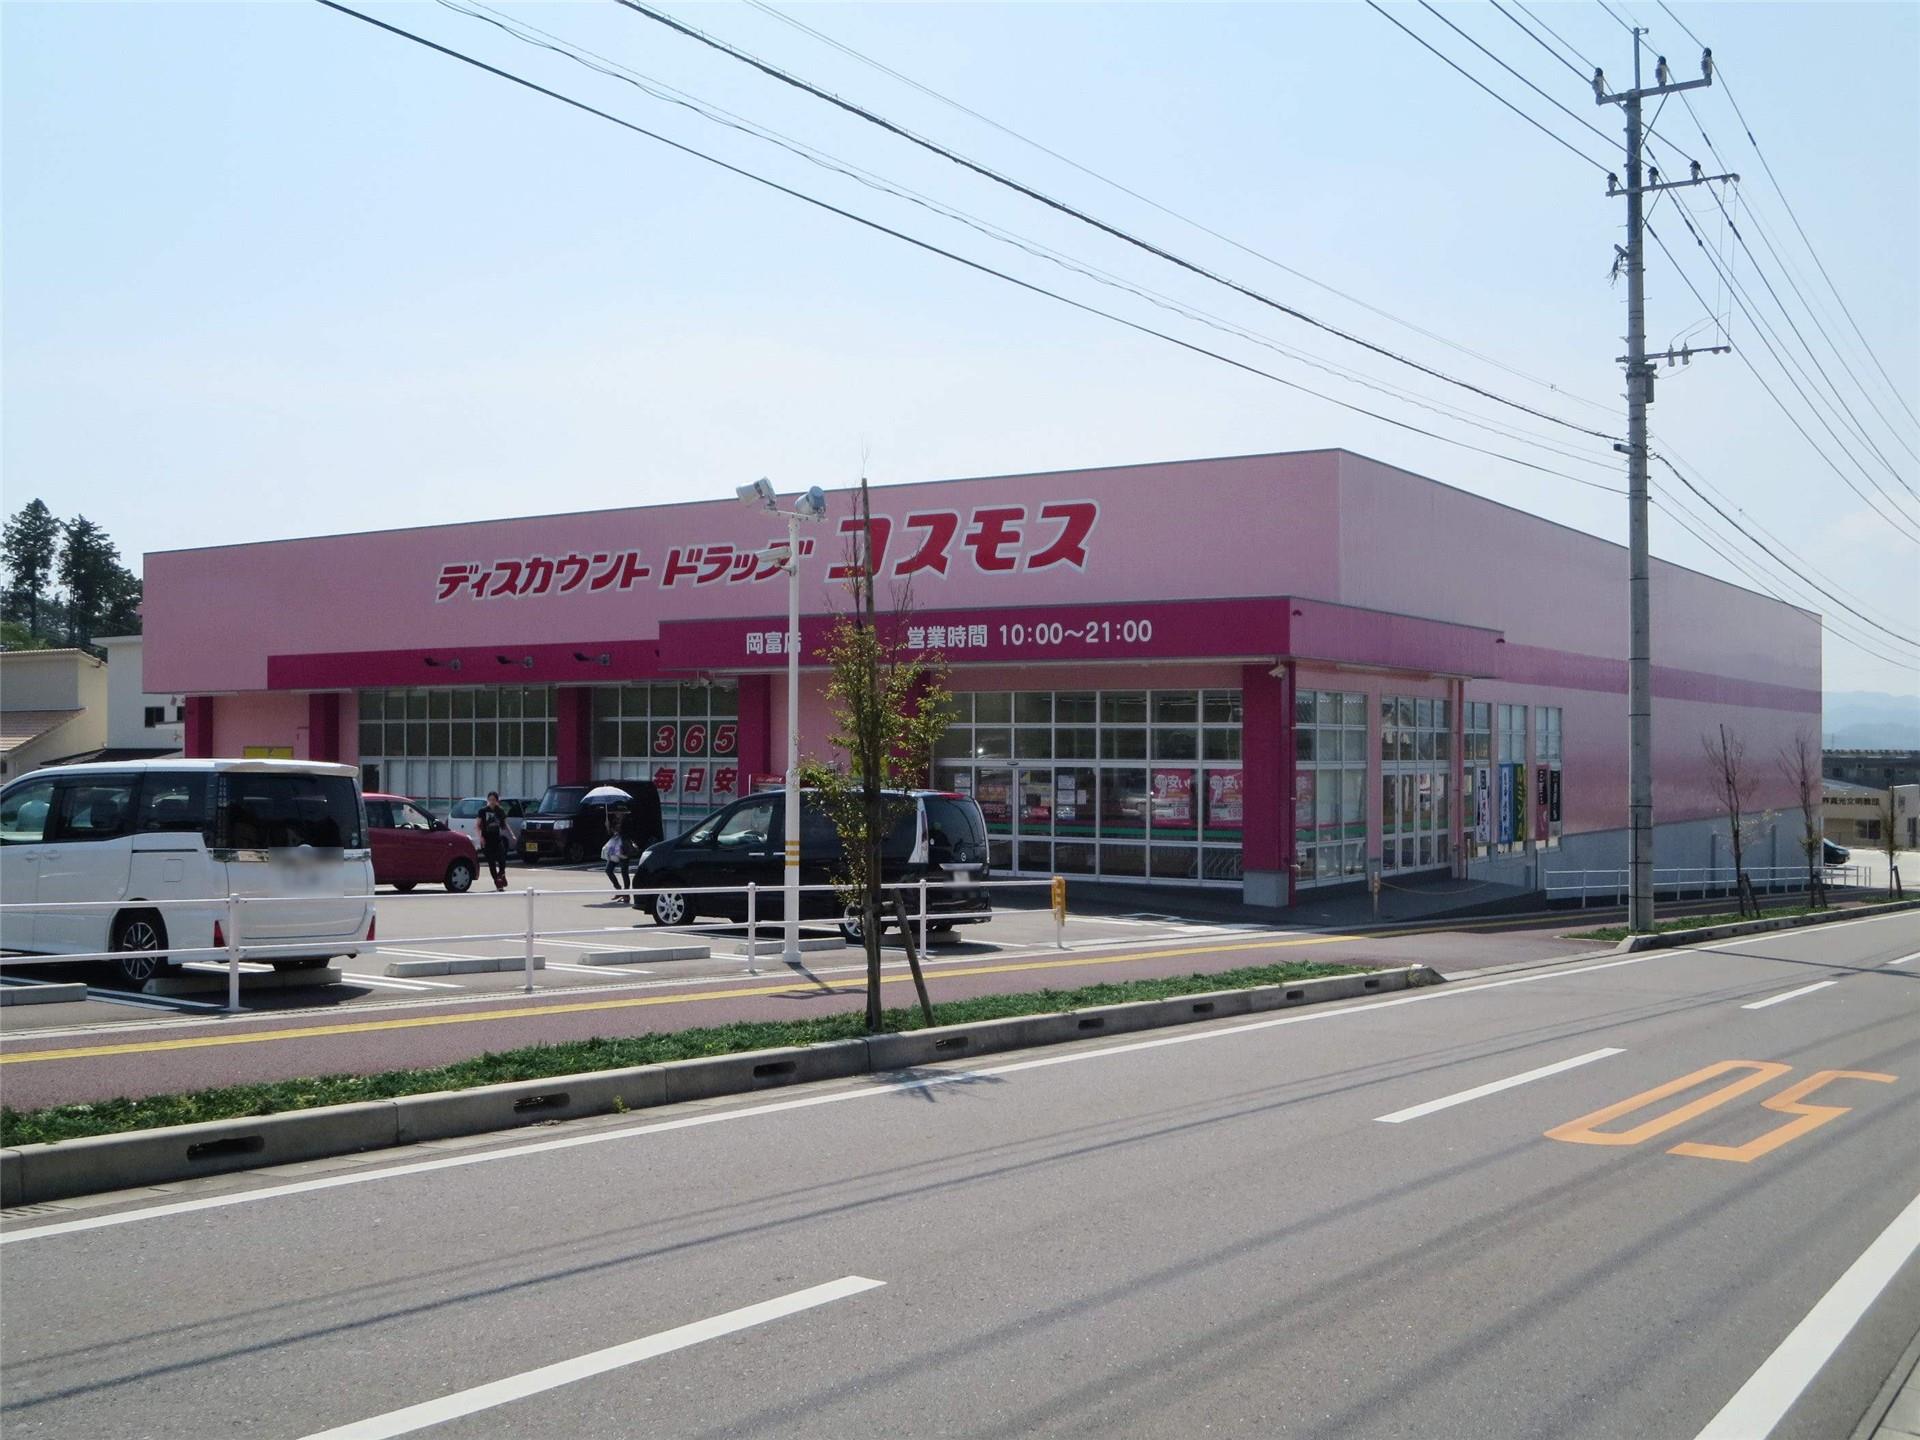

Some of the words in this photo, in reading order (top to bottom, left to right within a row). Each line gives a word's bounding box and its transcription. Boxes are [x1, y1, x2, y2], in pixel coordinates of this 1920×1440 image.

[438, 552, 651, 599] ディスカウント
[826, 501, 1097, 580] コスモス
[907, 625, 988, 649] 営業時間
[653, 724, 738, 753] 365
[653, 766, 738, 794] 毎日安
